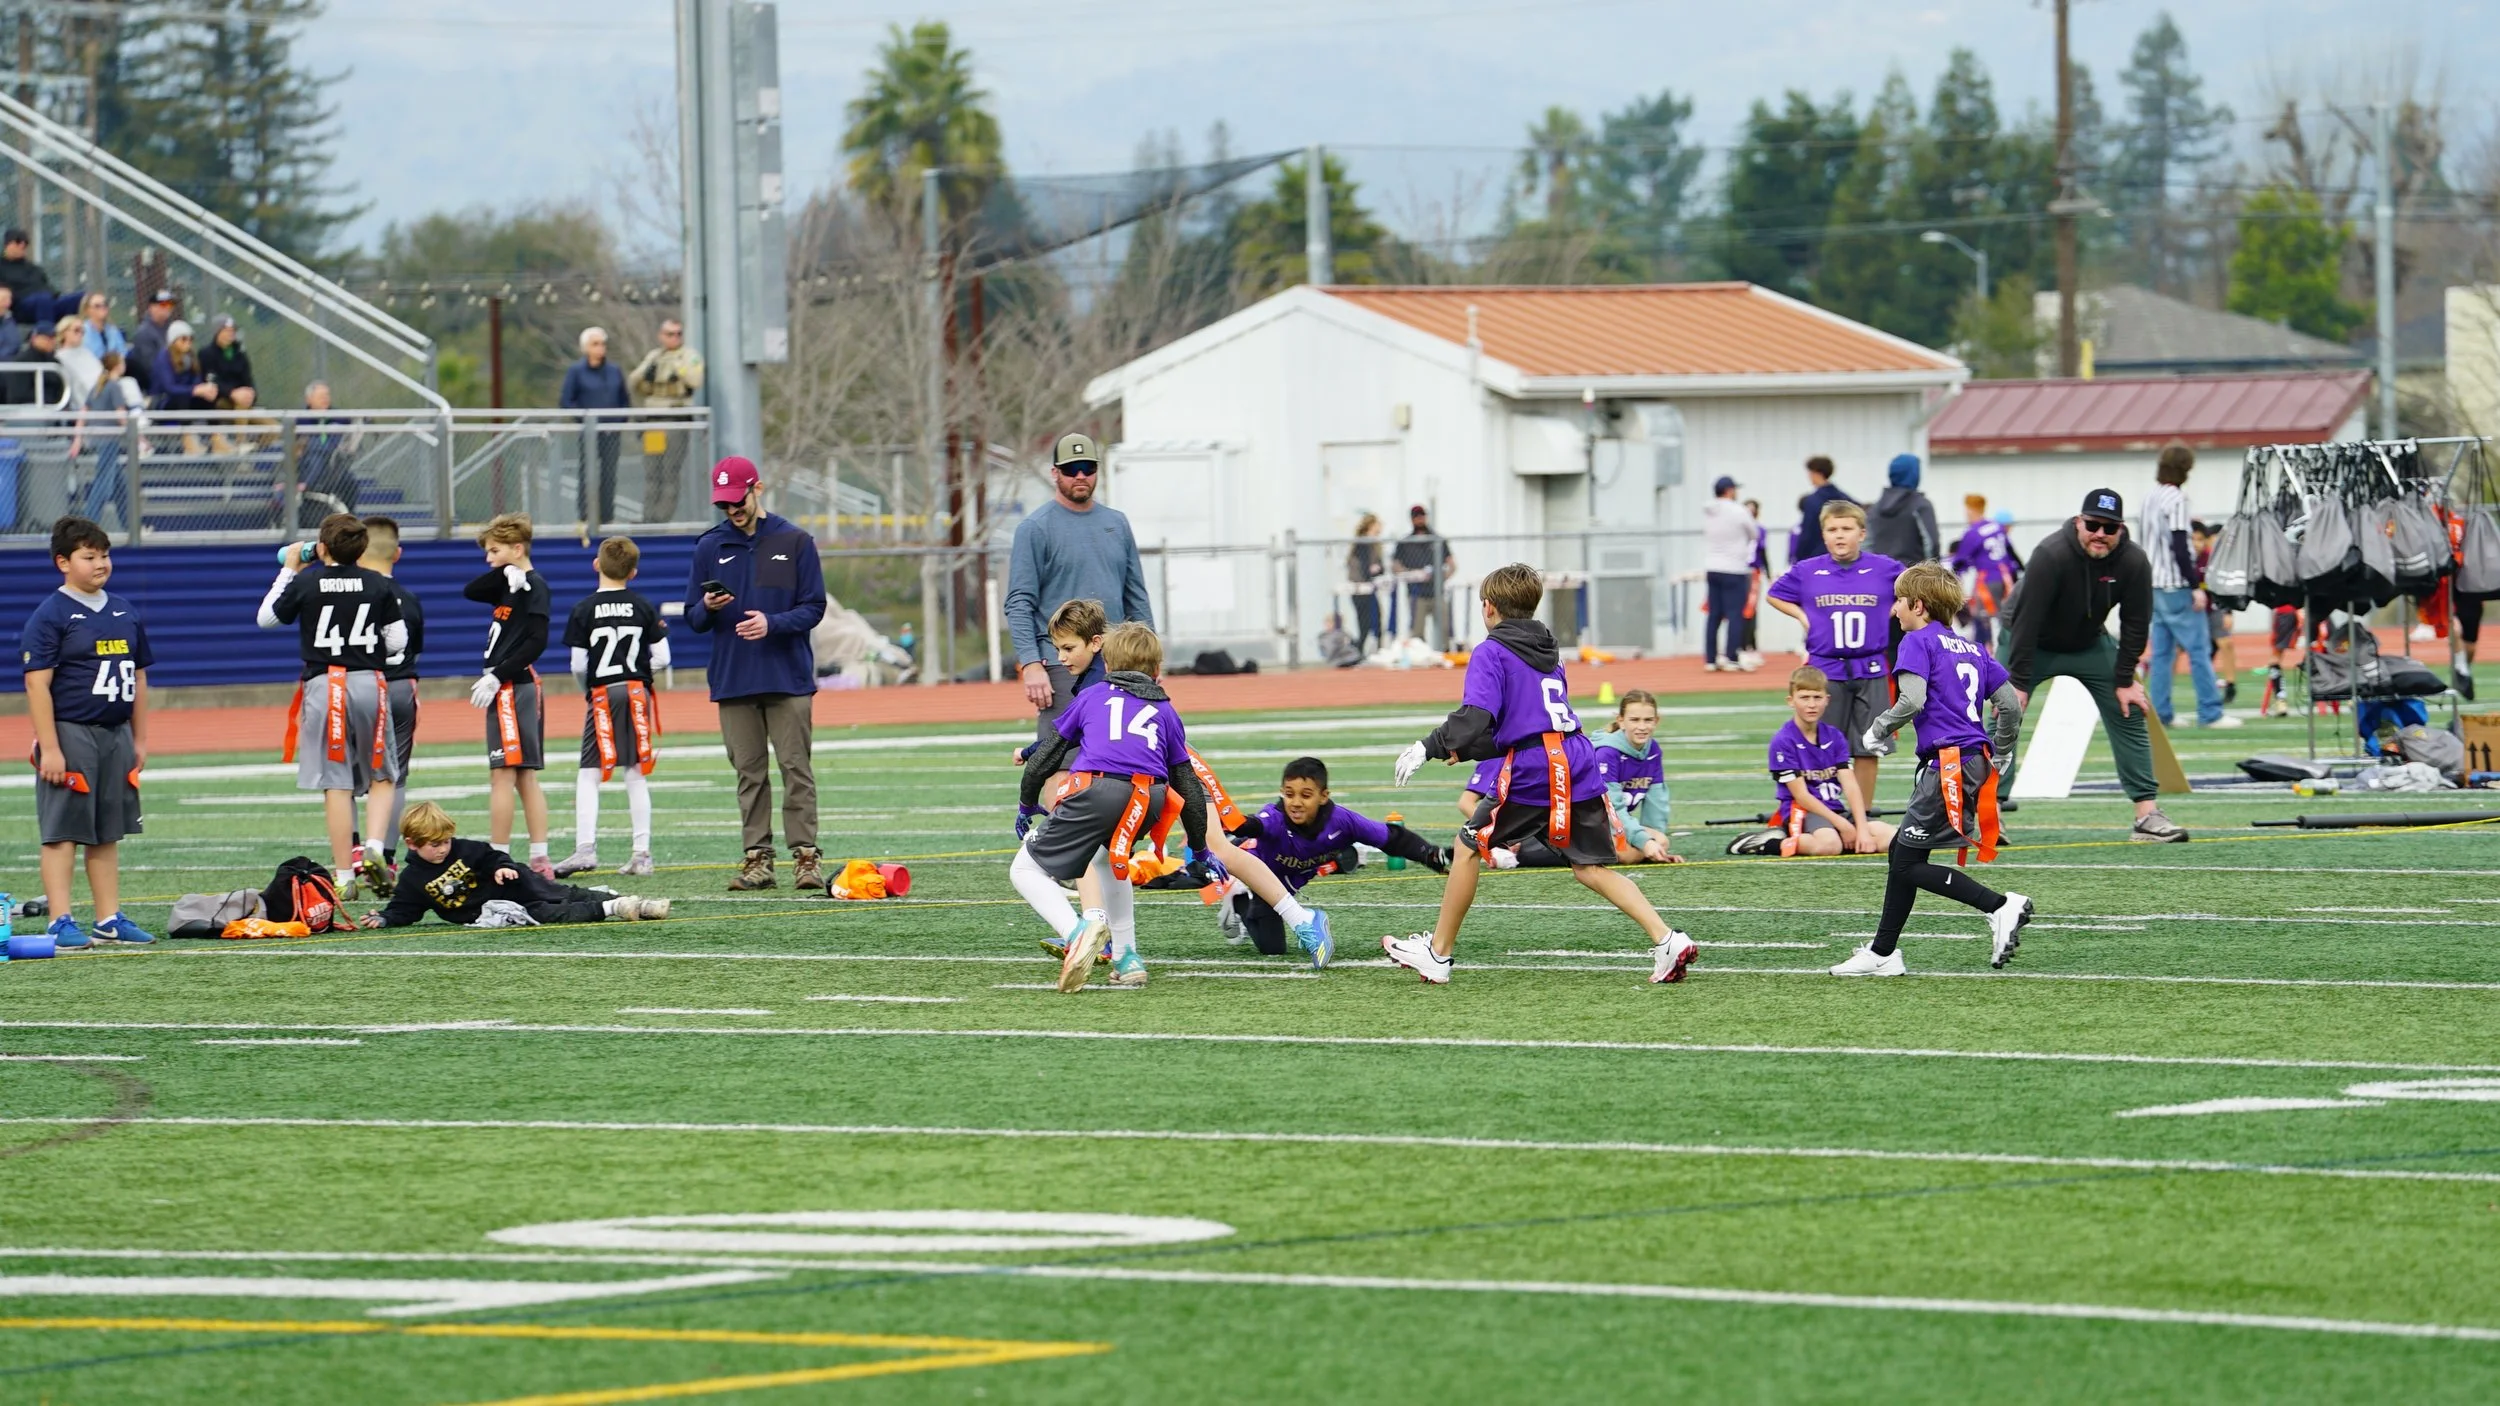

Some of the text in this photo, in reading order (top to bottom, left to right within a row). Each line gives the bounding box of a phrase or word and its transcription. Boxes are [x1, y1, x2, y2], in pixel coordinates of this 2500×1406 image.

[319, 578, 364, 593] BROWN
[1814, 594, 1878, 607] HUSKIES
[314, 603, 379, 657] 44
[594, 603, 634, 619] ADAMS
[1830, 611, 1866, 650] 10
[95, 639, 130, 656] BEARS
[590, 625, 644, 678] 27
[92, 660, 136, 702] 48
[330, 683, 342, 741] NEXT LEVEL
[499, 689, 516, 742] NEXT LEVEL
[596, 707, 610, 733] NEXT
[633, 699, 645, 725] NEXT
[1104, 696, 1159, 751] 14
[1541, 677, 1577, 732] 6
[1204, 774, 1225, 804] LEVEL
[1552, 763, 1567, 831] NEXT LEVEL
[1944, 777, 1959, 809] NEXT
[1114, 799, 1144, 858] NEXT LEVEL
